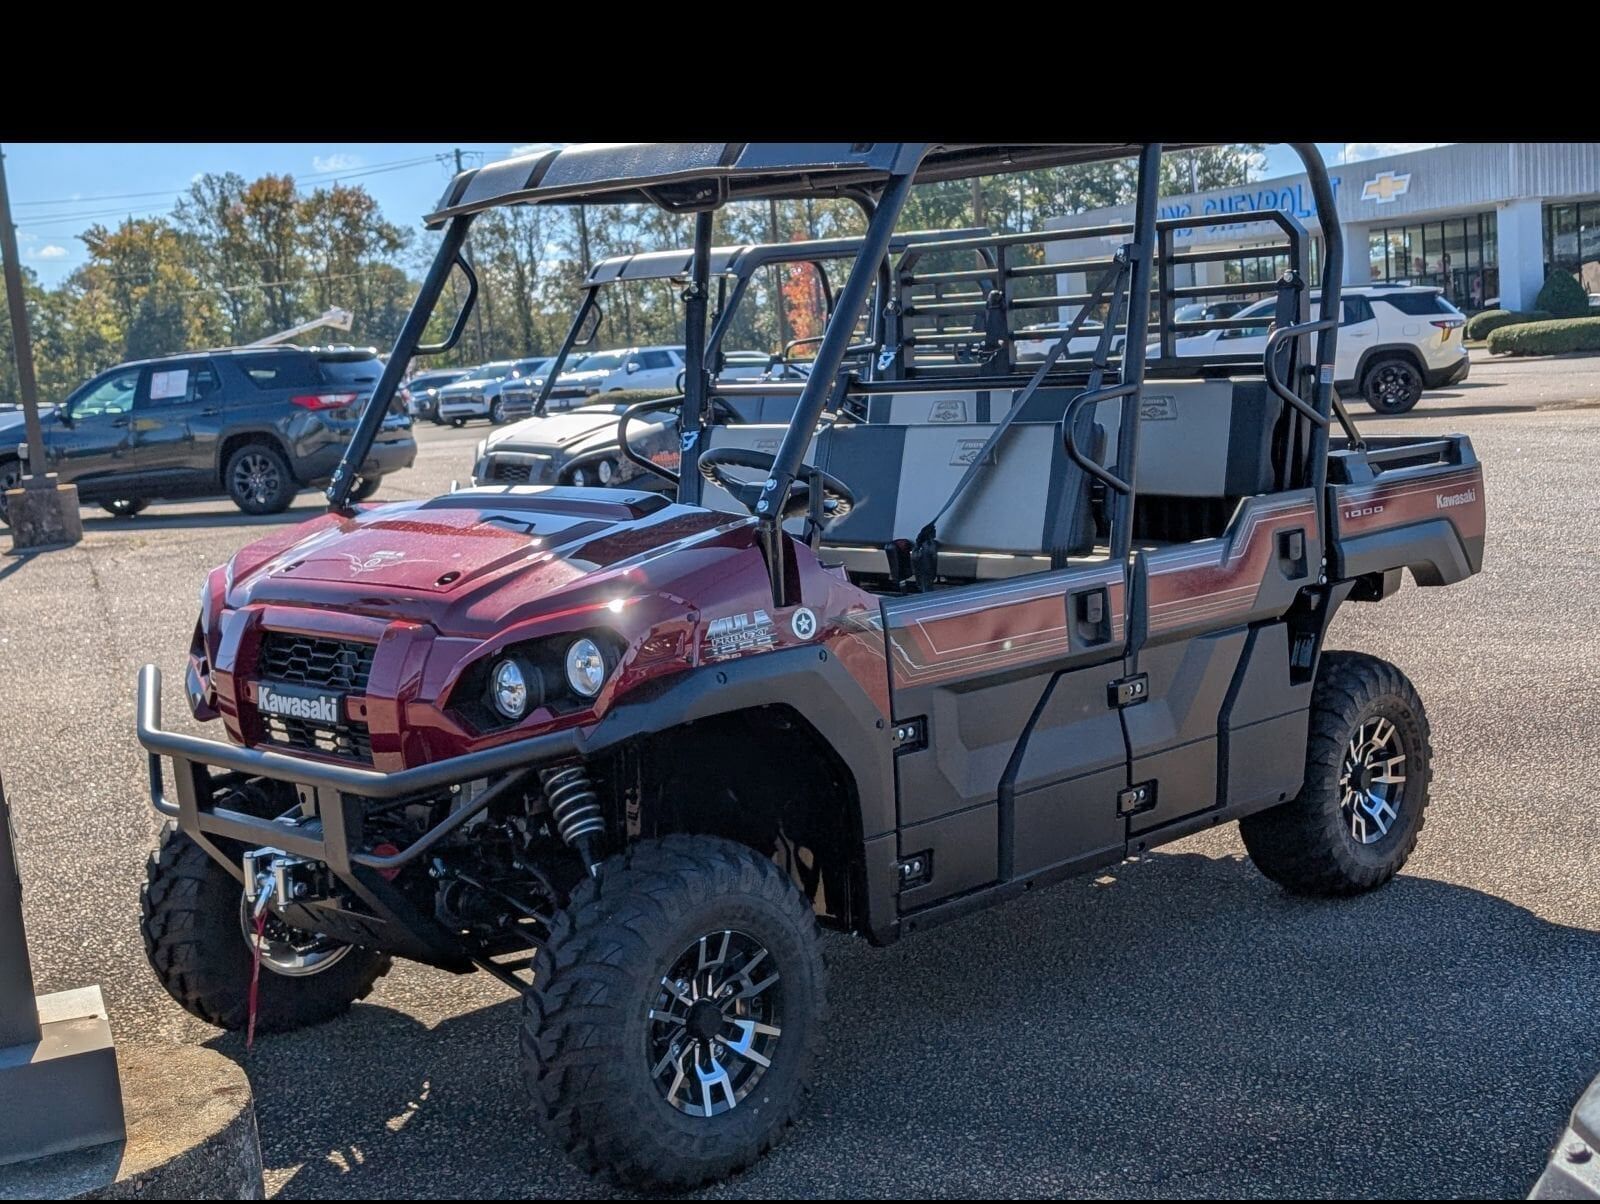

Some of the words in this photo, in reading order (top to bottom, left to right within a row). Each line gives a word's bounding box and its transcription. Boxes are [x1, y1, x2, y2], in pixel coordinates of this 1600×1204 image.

[1204, 177, 1341, 233] CHEVROLT
[1344, 505, 1384, 518] 1000
[1436, 488, 1476, 509] Kawasaki
[705, 609, 774, 641] MULE
[258, 686, 337, 722] Kawasaki
